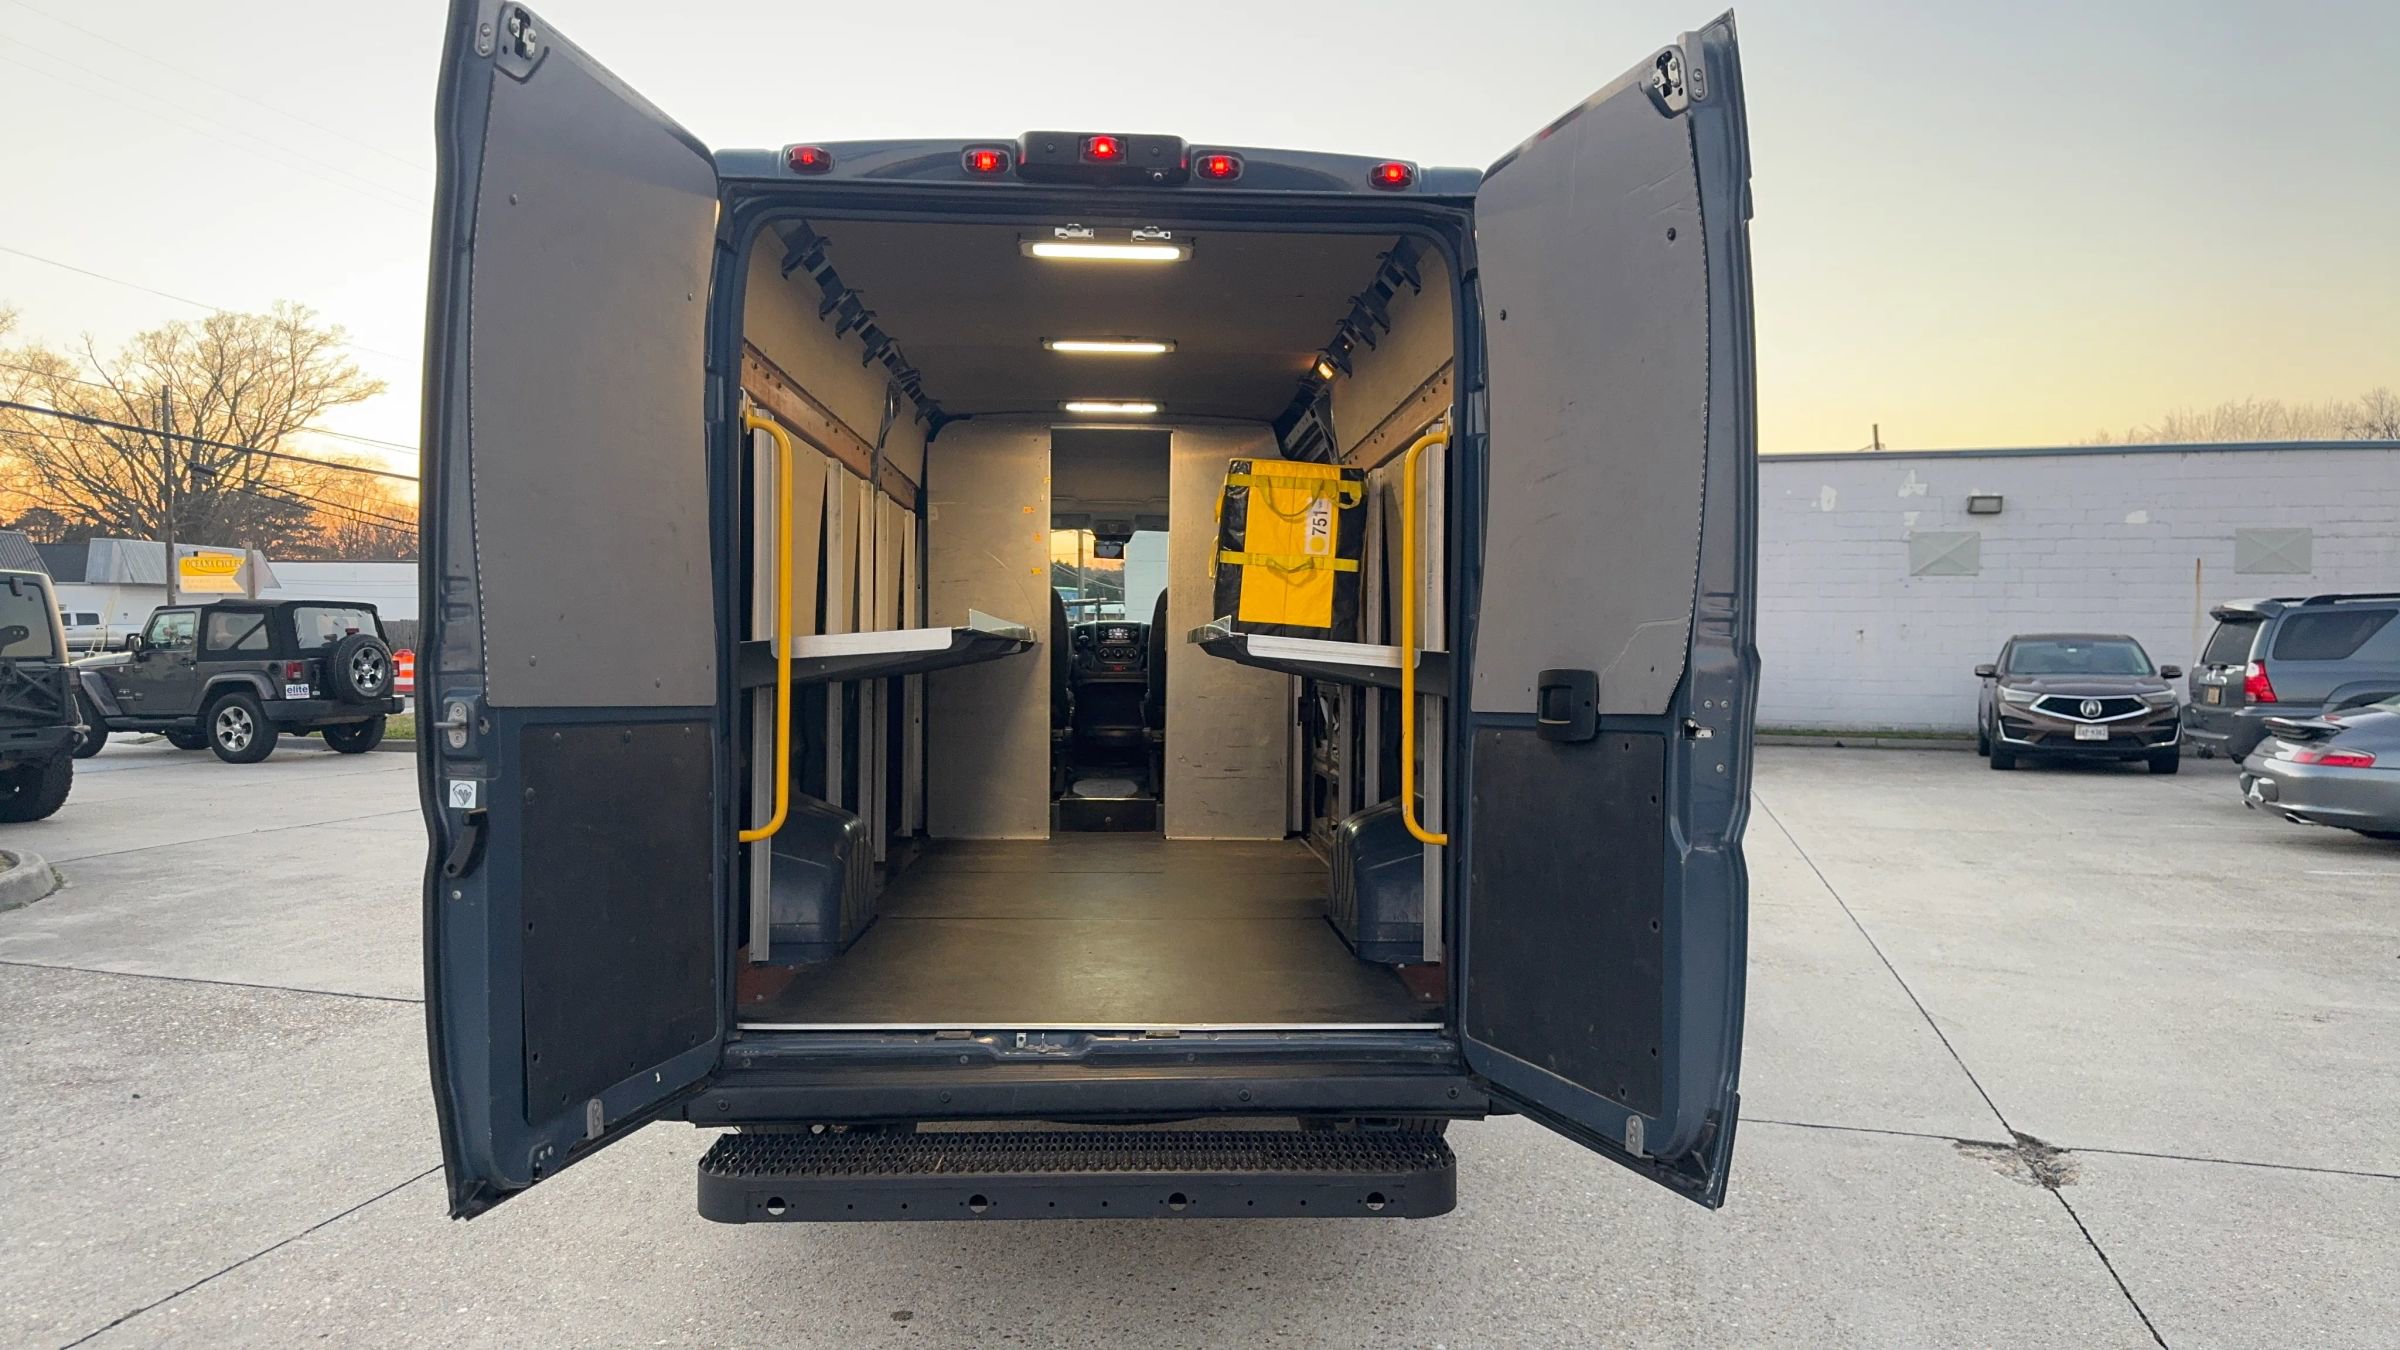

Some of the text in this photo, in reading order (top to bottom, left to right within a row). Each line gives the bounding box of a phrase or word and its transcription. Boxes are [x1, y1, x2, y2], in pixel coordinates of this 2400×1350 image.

[1312, 511, 1328, 536] 751
[185, 559, 215, 568] OCEANA
[287, 685, 308, 694] elite
